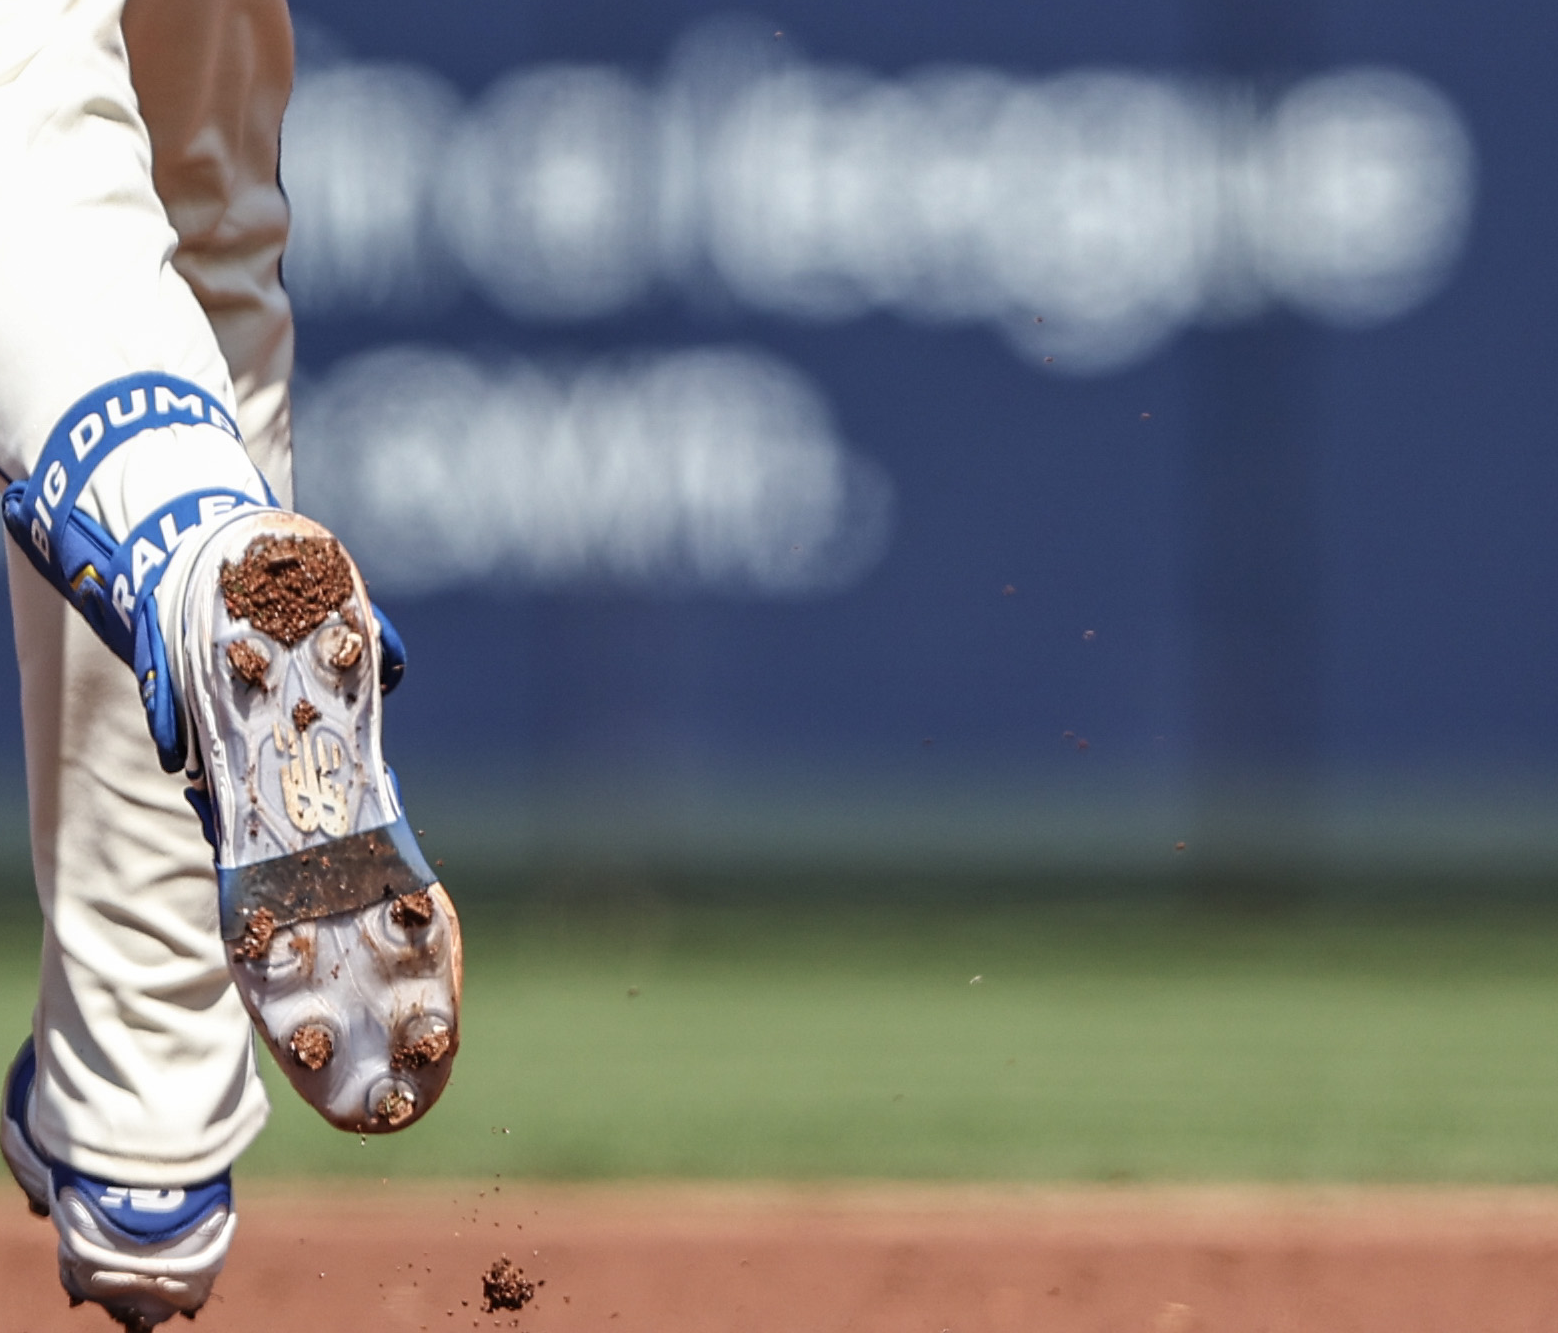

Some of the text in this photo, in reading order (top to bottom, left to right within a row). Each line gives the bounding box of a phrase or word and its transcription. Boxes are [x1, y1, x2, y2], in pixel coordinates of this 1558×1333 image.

[31, 386, 241, 565] BIG DUMP
[112, 495, 252, 632] RALE
